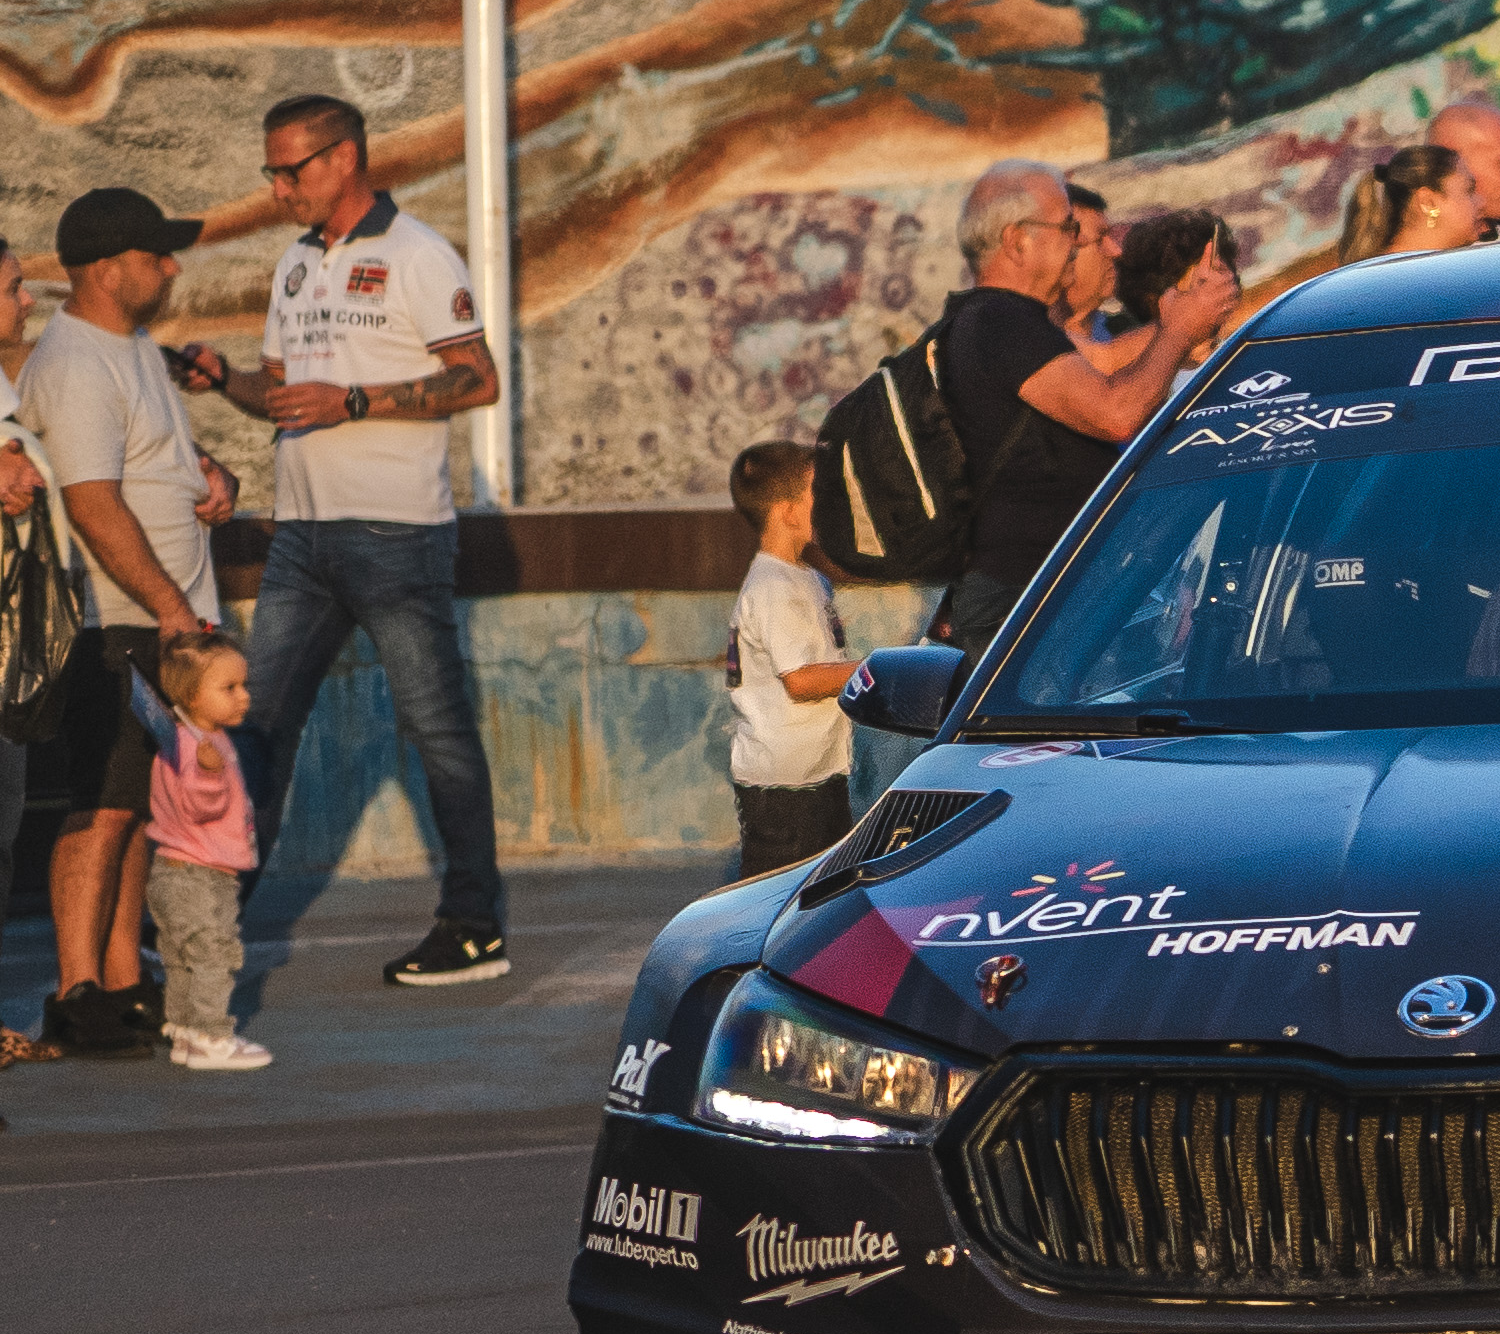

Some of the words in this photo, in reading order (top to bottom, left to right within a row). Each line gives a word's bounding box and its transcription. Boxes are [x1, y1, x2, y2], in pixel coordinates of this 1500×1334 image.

[295, 309, 332, 326] TEAM
[1315, 561, 1365, 583] OMP
[1147, 920, 1417, 957] HOFFMAN
[591, 1175, 667, 1237] Mobil
[585, 1232, 699, 1270] www.lubexpert.ro
[735, 1212, 901, 1282] Milwaukee
